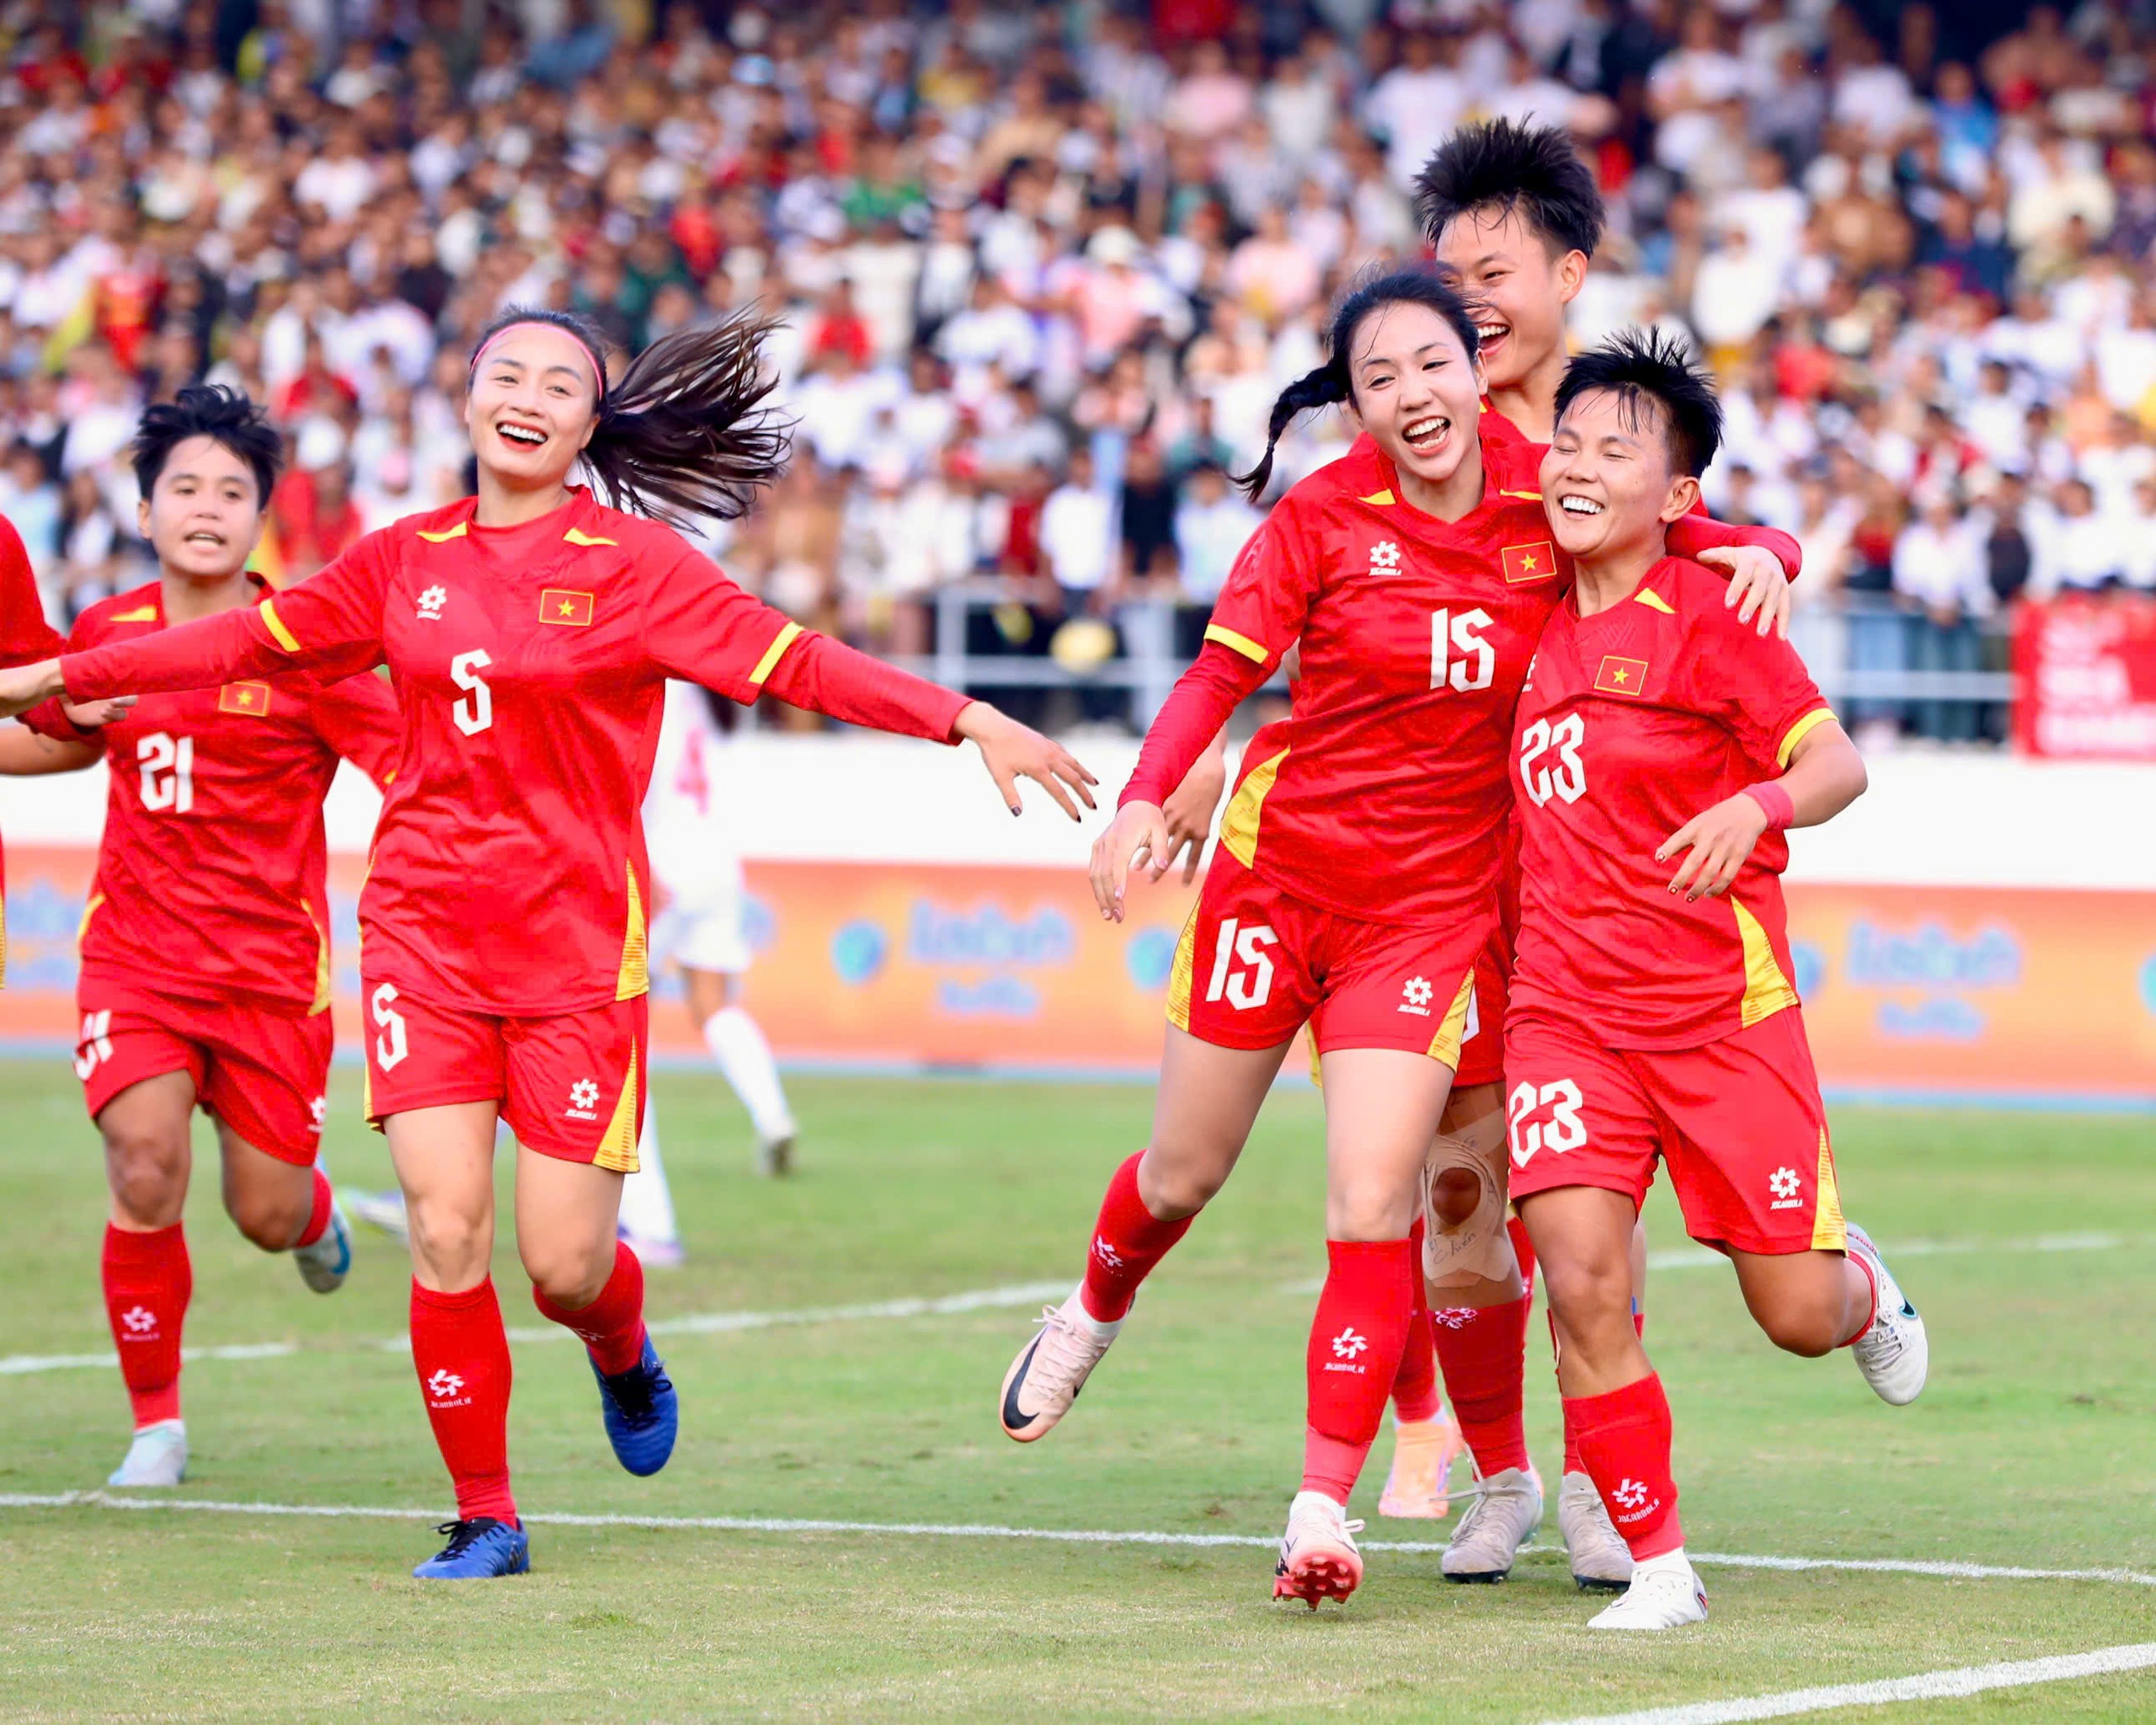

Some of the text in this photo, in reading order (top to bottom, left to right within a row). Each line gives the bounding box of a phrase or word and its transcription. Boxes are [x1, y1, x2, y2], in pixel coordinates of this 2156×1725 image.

[451, 648, 493, 736] 5
[1431, 607, 1495, 692] 15
[137, 733, 193, 814] 21
[1520, 712, 1588, 809] 23
[1205, 918, 1278, 1011] 15
[371, 982, 408, 1072] 5
[1508, 1078, 1588, 1169] 23
